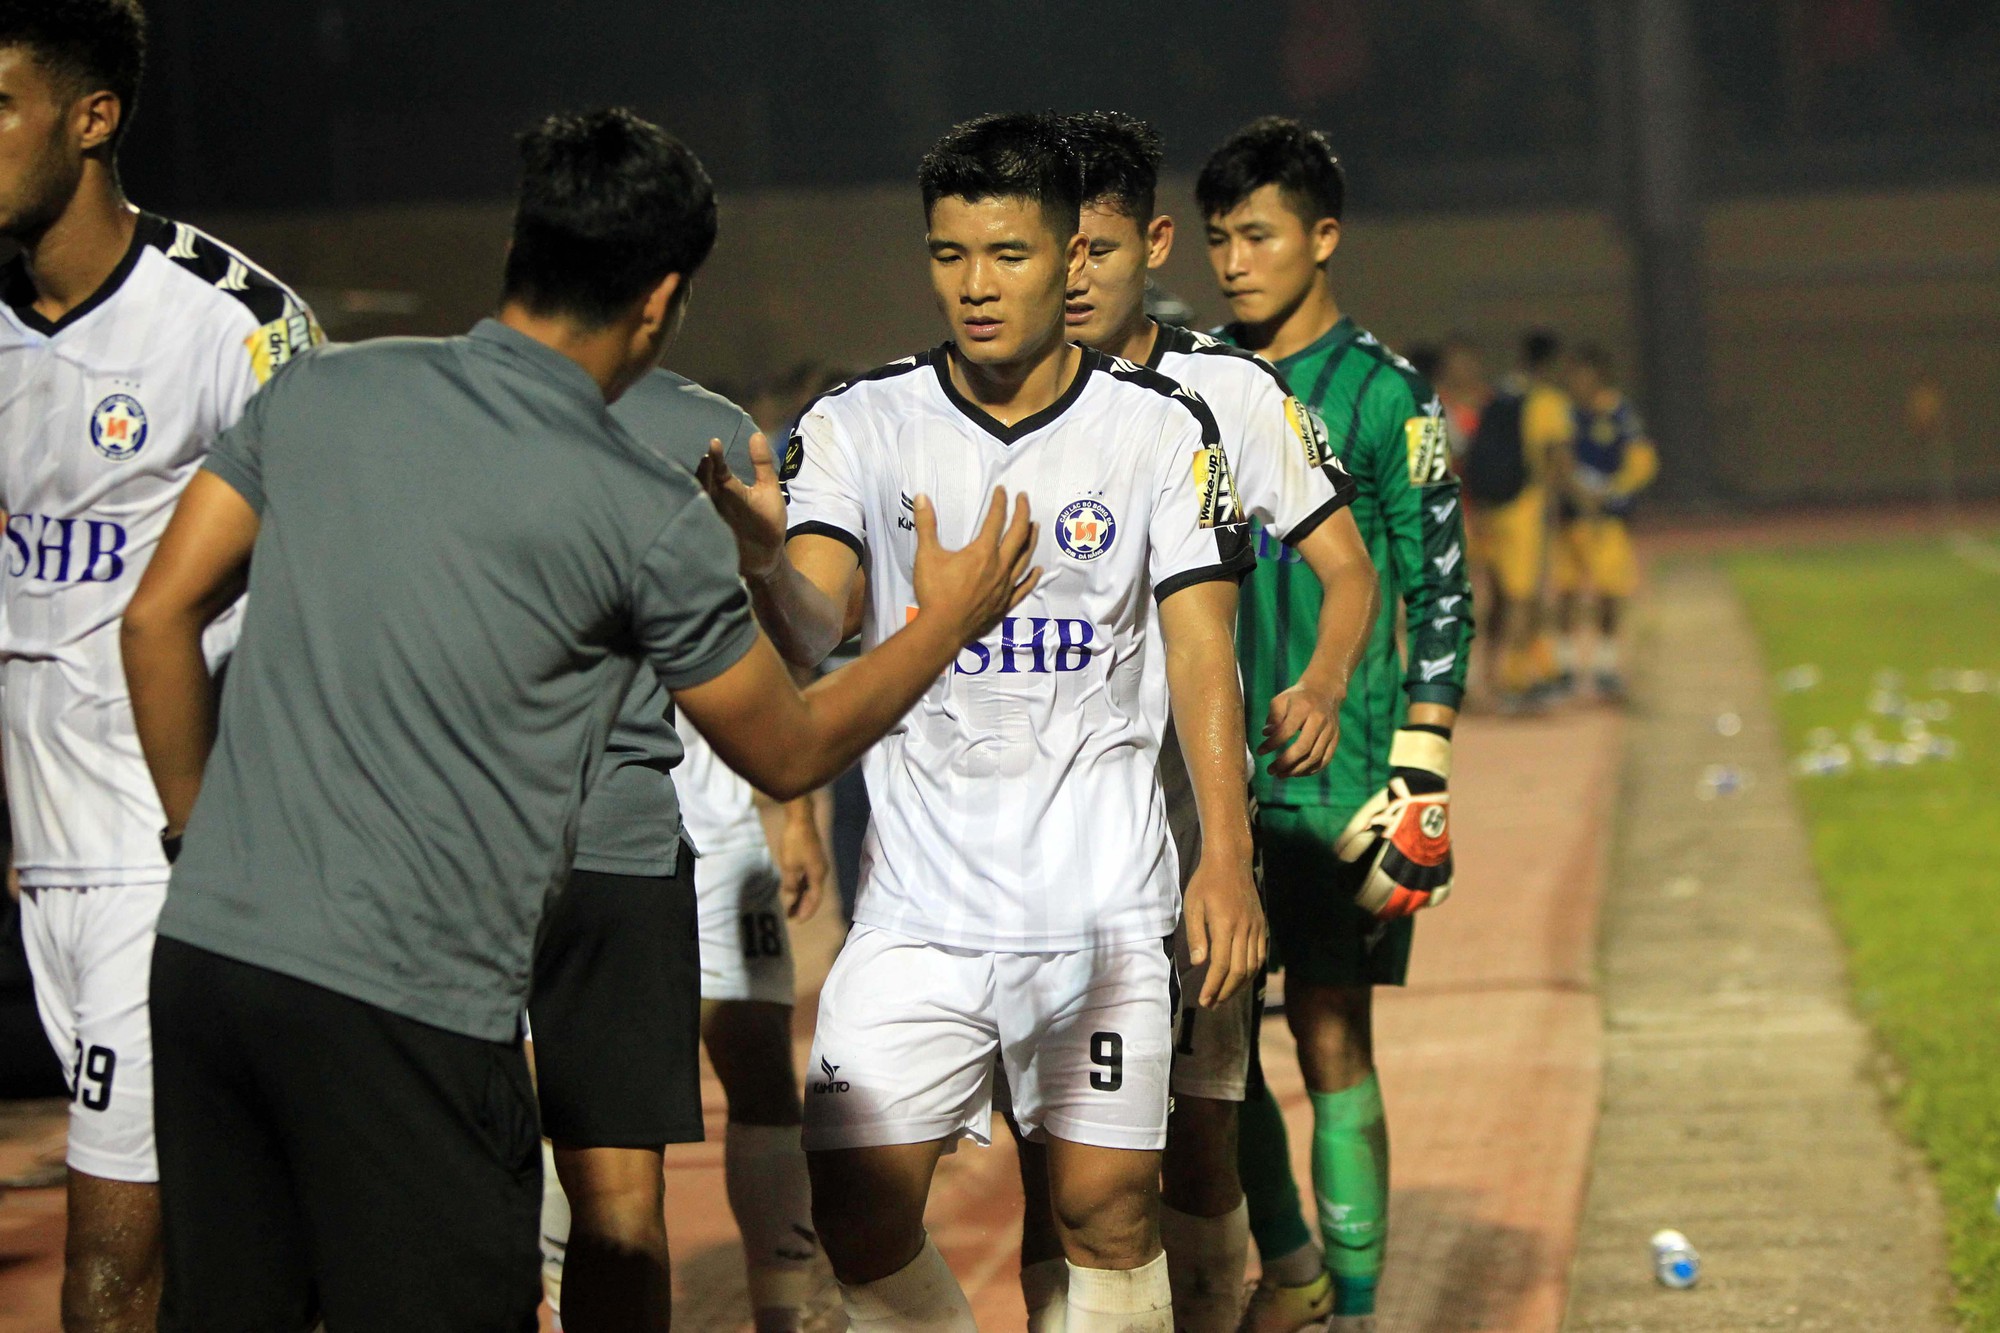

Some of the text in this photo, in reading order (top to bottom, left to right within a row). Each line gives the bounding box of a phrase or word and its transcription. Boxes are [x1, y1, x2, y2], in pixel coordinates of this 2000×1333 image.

[1200, 454, 1220, 520] Wake-up
[6, 514, 126, 582] SHB
[740, 911, 782, 959] 18
[814, 1081, 850, 1094] KAMITO
[1090, 1031, 1123, 1092] 9
